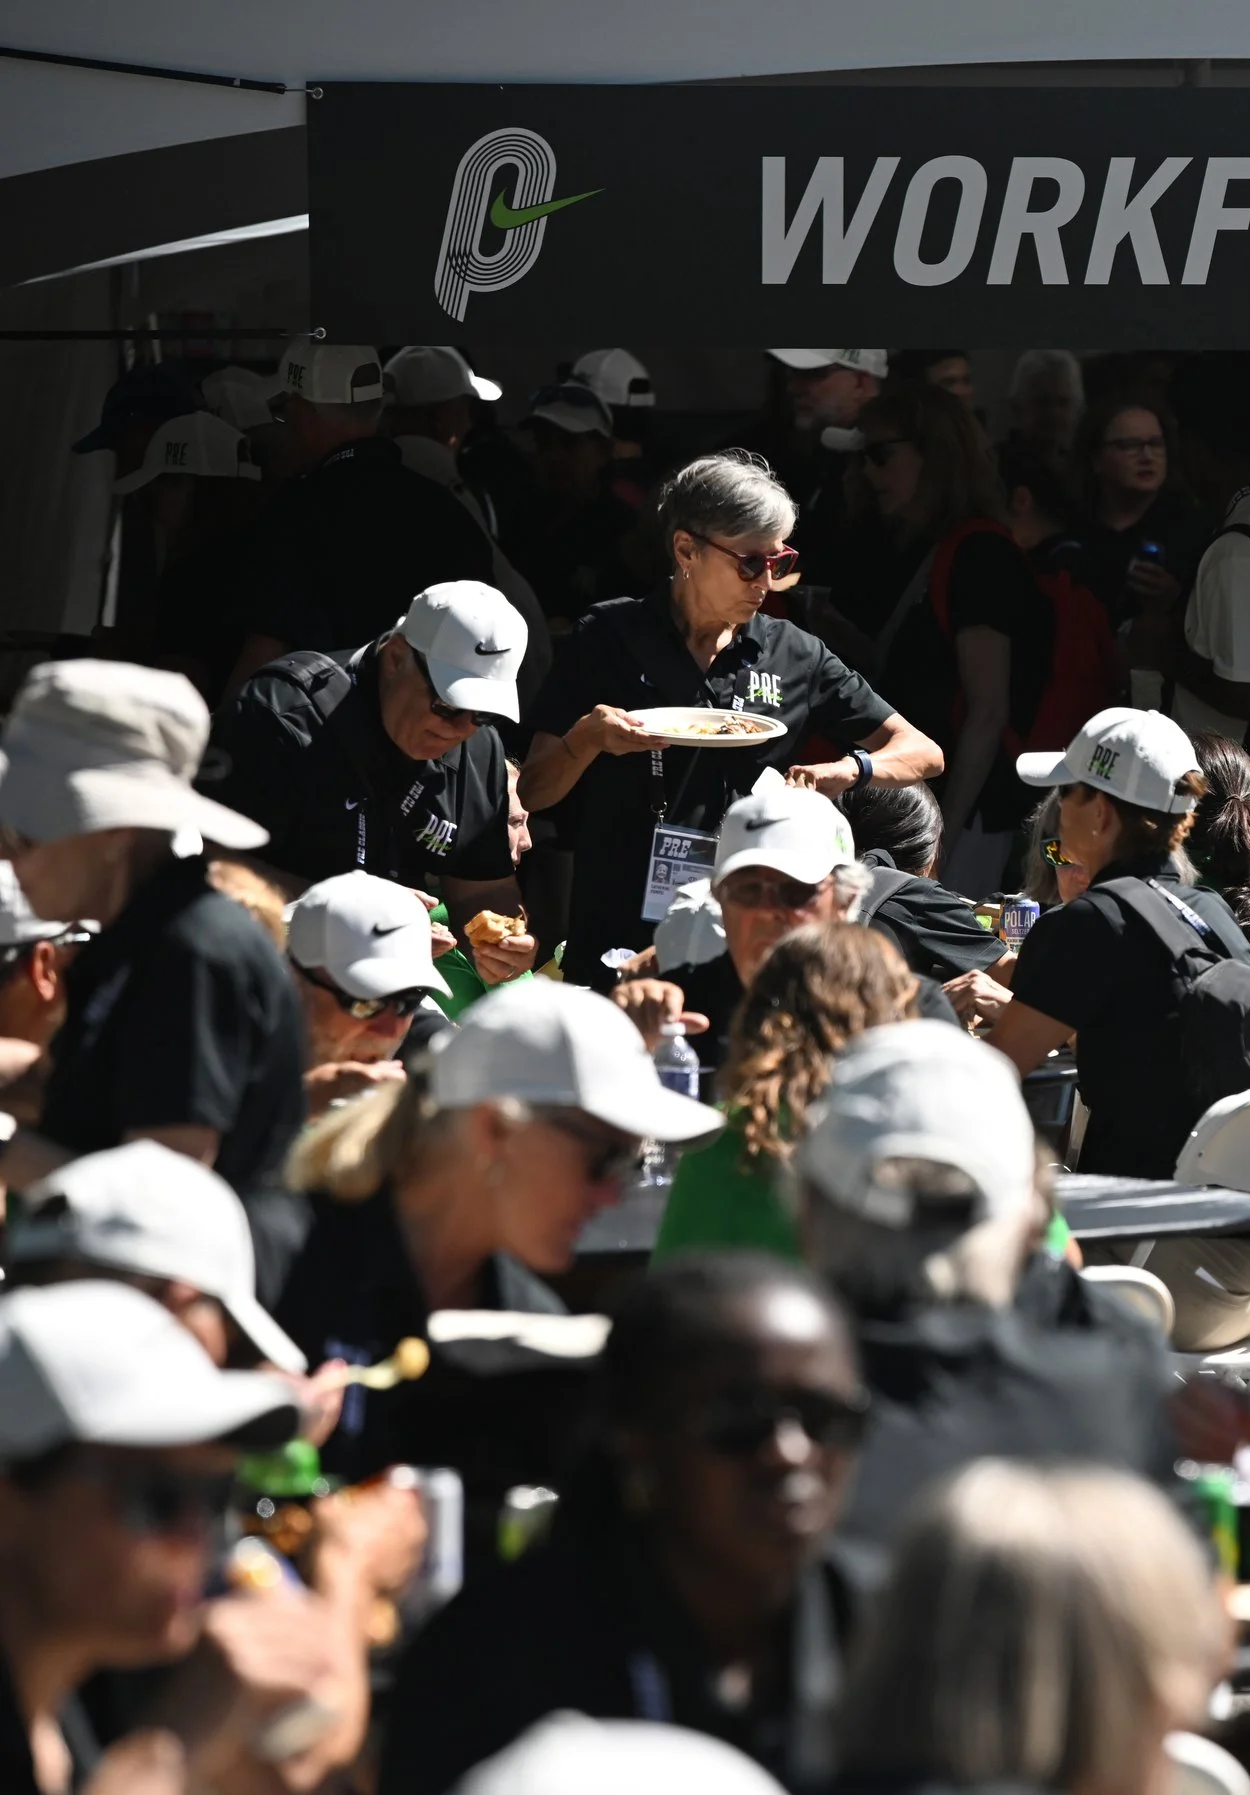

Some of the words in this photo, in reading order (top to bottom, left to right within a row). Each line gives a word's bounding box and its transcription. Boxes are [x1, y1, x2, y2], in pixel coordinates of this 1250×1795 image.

[287, 361, 306, 389] PRE
[165, 441, 189, 466] PRE
[749, 670, 782, 708] PRE
[651, 760, 664, 777] PRE
[1088, 744, 1120, 780] PRE
[416, 813, 458, 857] PRE
[659, 836, 692, 859] PRE
[1004, 910, 1036, 929] POLAR
